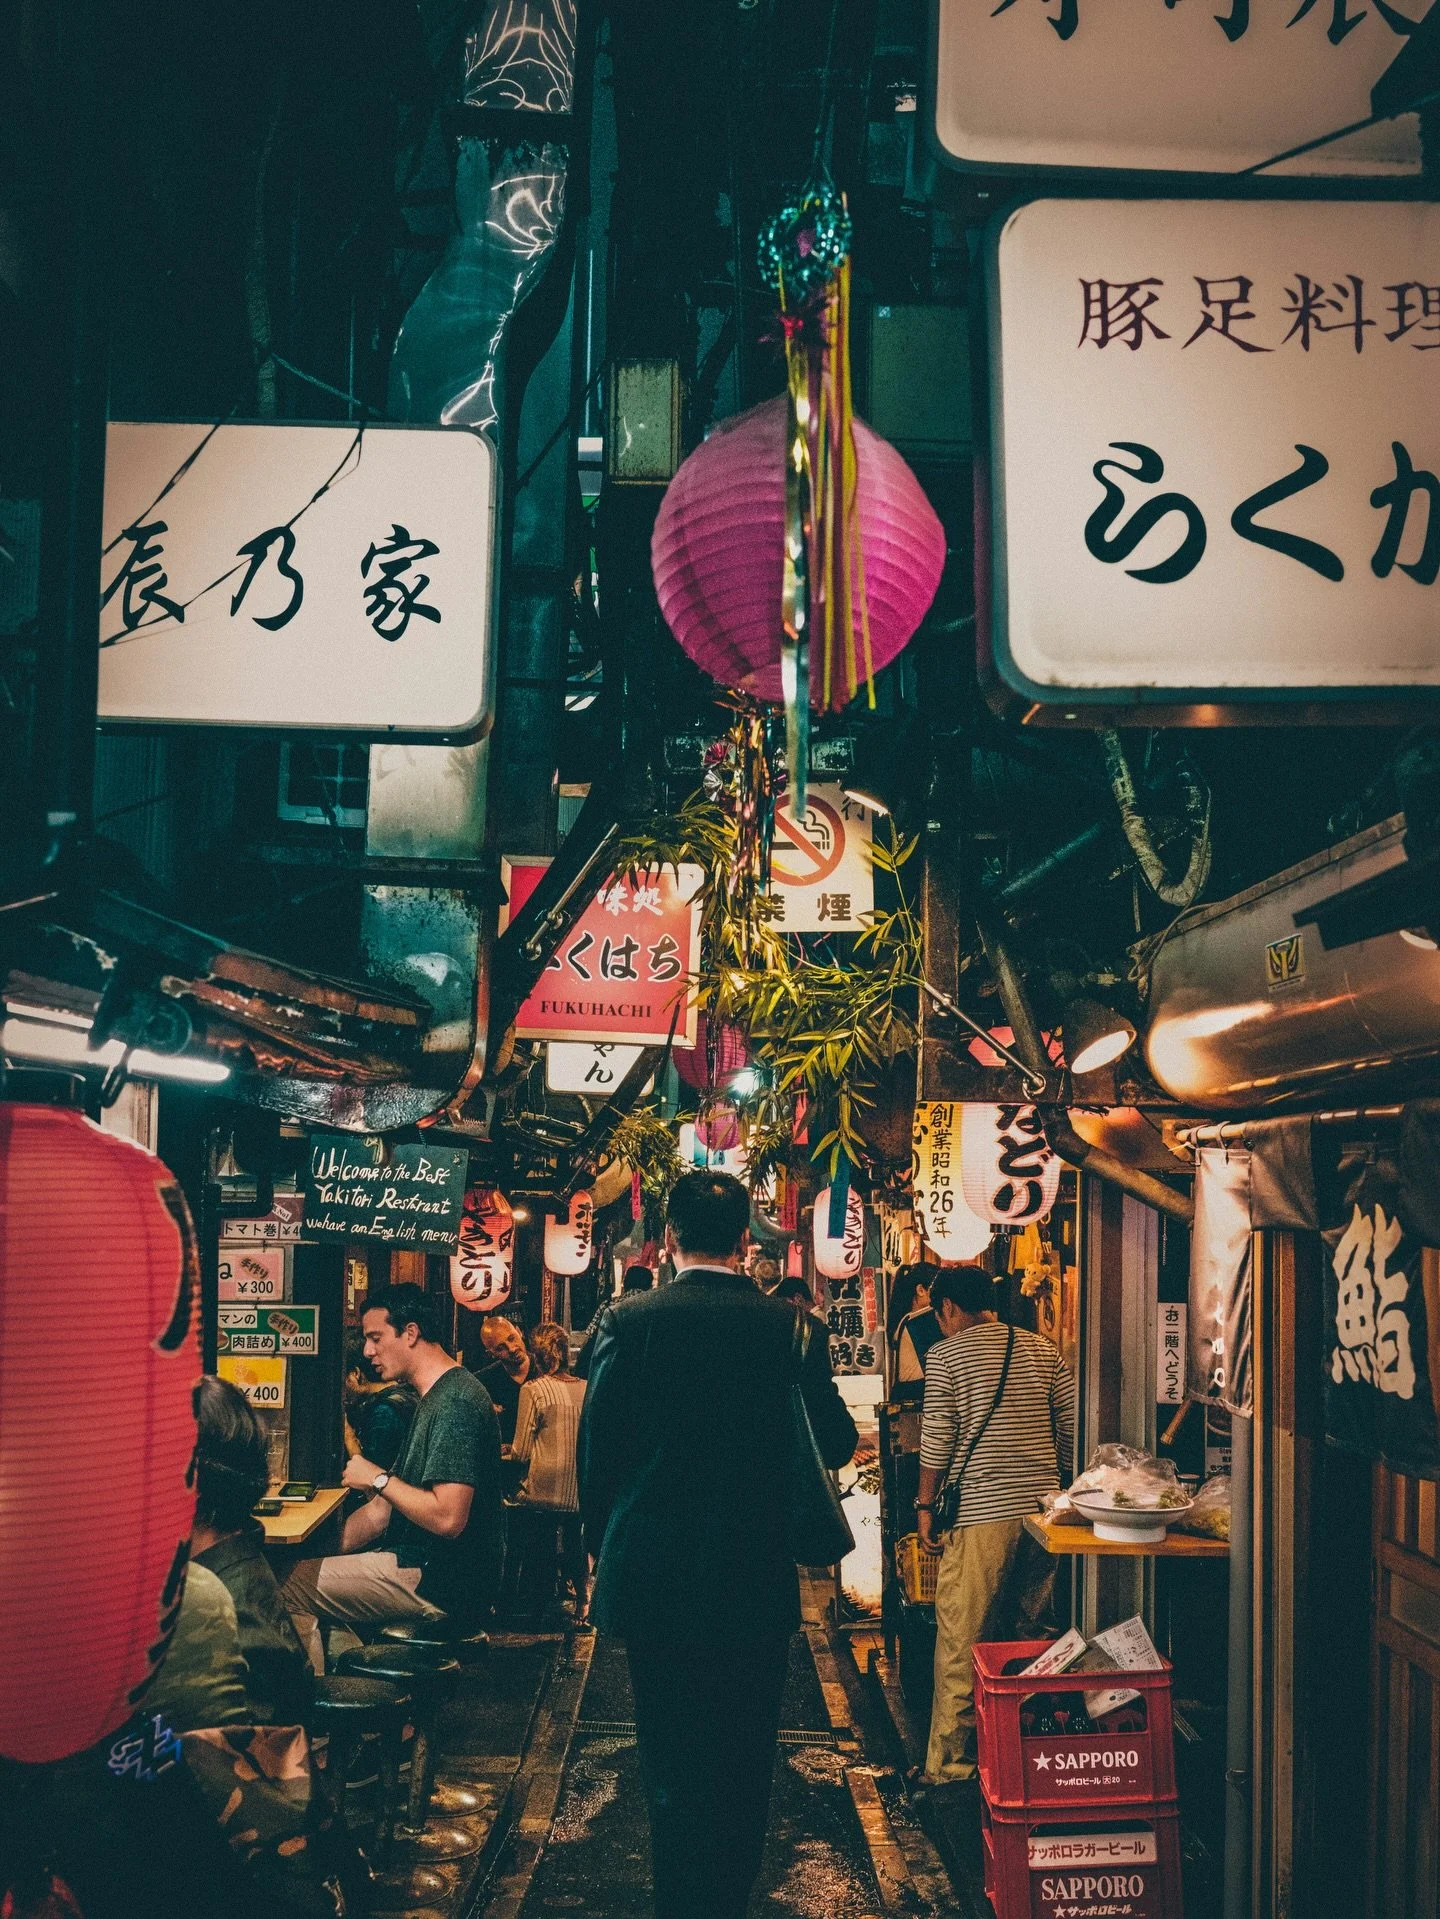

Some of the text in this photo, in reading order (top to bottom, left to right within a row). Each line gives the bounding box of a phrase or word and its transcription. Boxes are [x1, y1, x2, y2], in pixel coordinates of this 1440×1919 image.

[1077, 273, 1440, 354] 豚足料理
[545, 930, 682, 982] くはち
[540, 1000, 652, 1018] FUKUHACHI
[311, 1146, 450, 1185] Welcome to the Best
[930, 1103, 954, 1239] 創業昭和26年
[225, 1222, 278, 1237] トマト巻
[351, 1223, 367, 1233] an
[368, 1216, 416, 1240] English
[238, 1281, 274, 1294] ¥300
[232, 1336, 312, 1349] 肉詰め ¥400
[1055, 1750, 1139, 1770] SAPPORO
[1055, 1776, 1101, 1787] サッポロビール
[1028, 1840, 1146, 1860] サッポロラガービール
[1041, 1875, 1145, 1901] SAPPORO
[1067, 1903, 1133, 1917] サッポロビール
